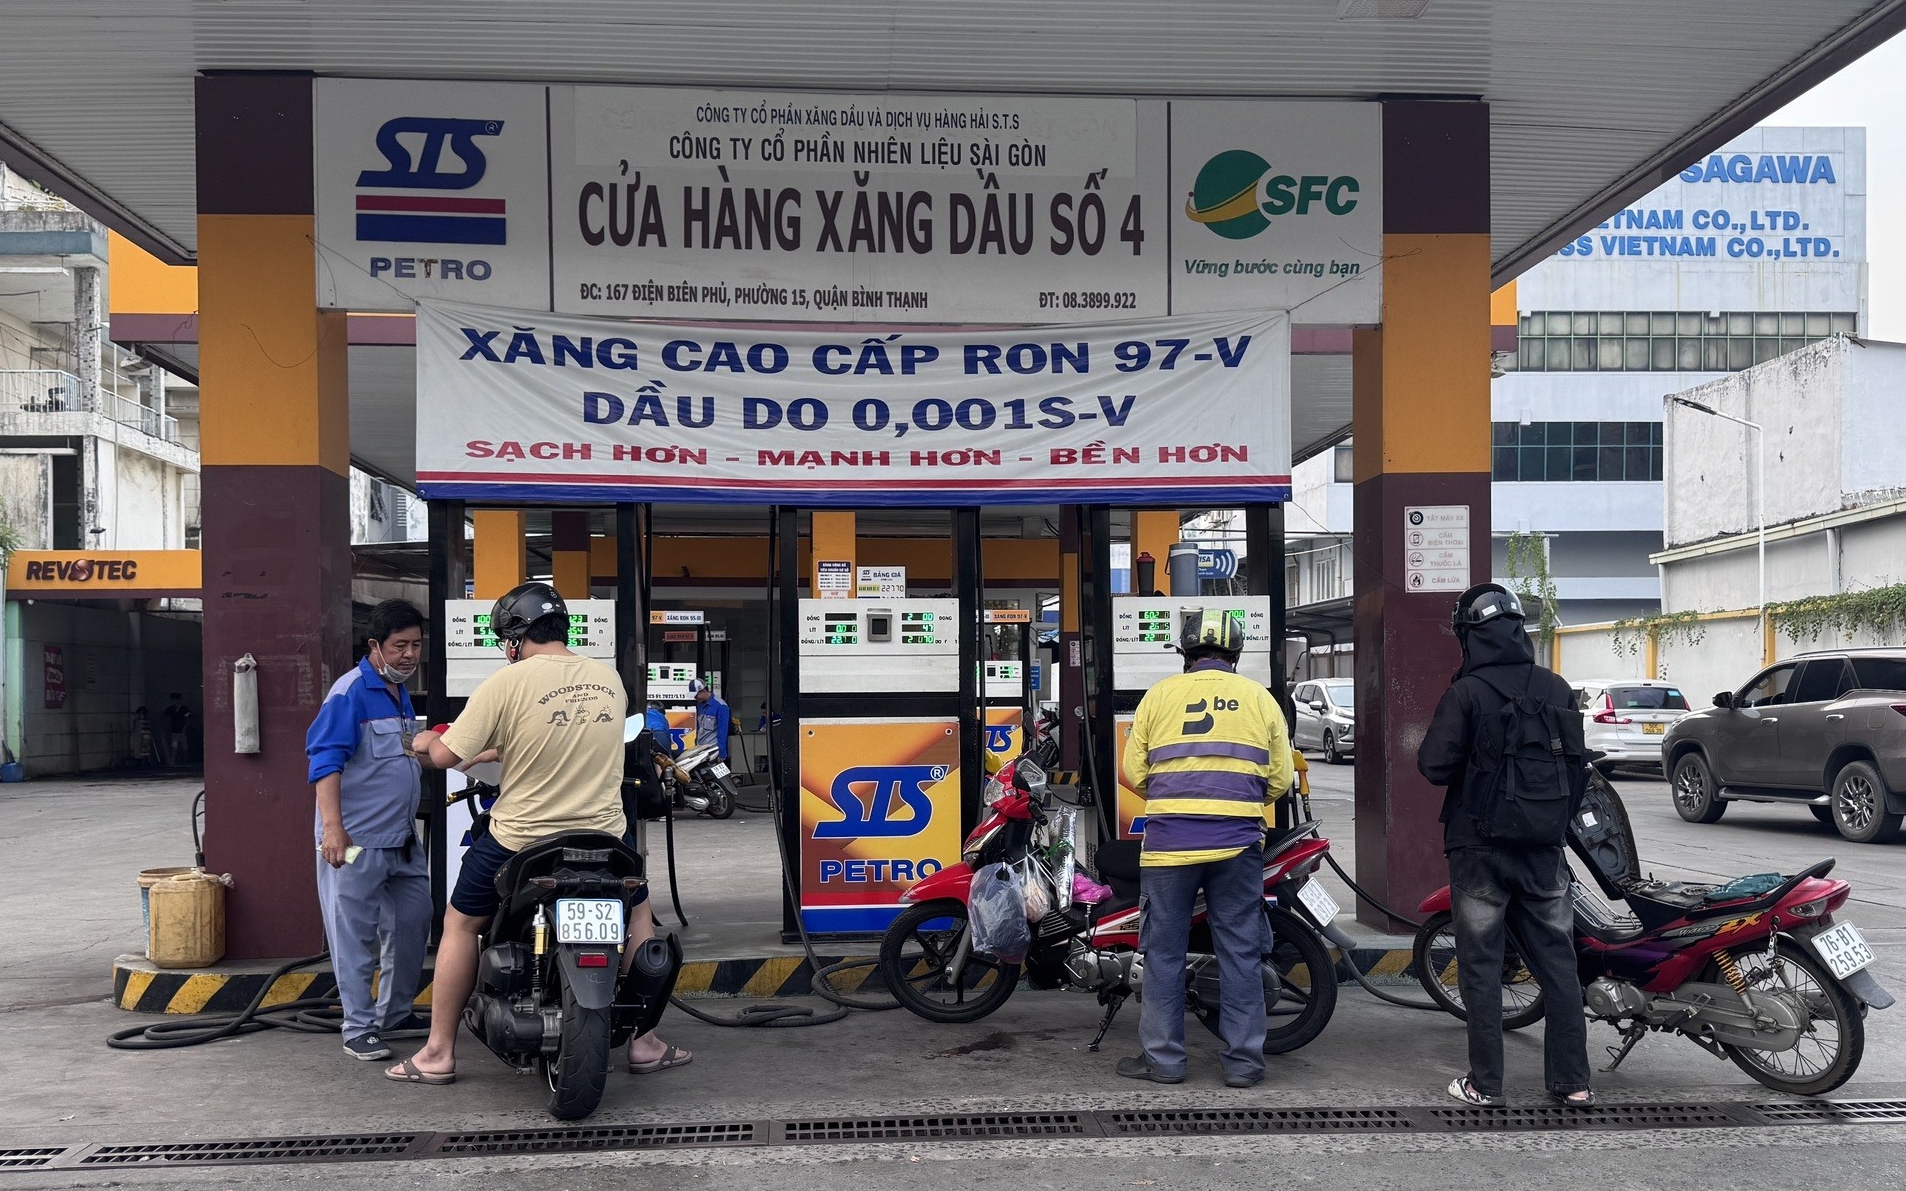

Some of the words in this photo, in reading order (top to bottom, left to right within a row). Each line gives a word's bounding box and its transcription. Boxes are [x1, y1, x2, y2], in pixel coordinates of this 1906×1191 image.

[696, 103, 730, 123] CÔNG
[733, 107, 748, 123] TY
[750, 100, 767, 124] CỔ
[771, 102, 801, 125] PHẦN
[805, 105, 837, 126] XĂNG
[841, 104, 864, 127] DẦU
[867, 108, 883, 127] VÀ
[886, 111, 913, 131] DỊCH
[916, 112, 931, 131] VỤ
[935, 108, 967, 129] HÀNG
[970, 107, 989, 130] HẢI
[992, 113, 1019, 130] S.T.S
[356, 117, 505, 190] STS
[669, 130, 721, 160] CÔNG
[729, 137, 753, 161] TY
[761, 127, 785, 162] CỔ
[794, 130, 845, 163] PHẦN
[853, 136, 912, 165] NHIÊN
[920, 137, 962, 170] LIỆU
[969, 138, 1000, 166] SÀI
[1008, 138, 1046, 167] GÒN
[1680, 154, 1837, 184] SAGAWA
[578, 159, 667, 247] CỬA
[683, 165, 801, 252] HÀNG
[815, 170, 932, 255] XĂNG
[950, 168, 1034, 255] DẦU
[1050, 168, 1109, 256] SỐ
[1120, 194, 1145, 256] 4
[1262, 175, 1360, 216] SFC
[1595, 209, 1683, 230] TNAM
[1558, 236, 1593, 257] SS
[1600, 236, 1717, 257] VIETNAM
[370, 256, 492, 281] PETRO
[1184, 259, 1229, 278] Vững
[1233, 258, 1278, 275] bước
[1283, 259, 1325, 278] cùng
[1329, 259, 1360, 278] bạn
[580, 283, 602, 301] ĐC:
[606, 284, 629, 301] 167
[632, 279, 664, 305] ĐIỆN
[667, 280, 698, 303] BIÊN
[701, 281, 731, 307] PHỦ,
[734, 282, 787, 306] PHƯỜNG
[791, 289, 810, 309] 15,
[813, 285, 848, 310] QUẬN
[852, 285, 883, 308] BÌNH
[886, 291, 928, 312] THẠNH
[1039, 292, 1060, 309] ĐT:
[1062, 292, 1136, 309] 08.3899.922
[459, 326, 639, 370] XĂNG
[661, 340, 790, 375] CAO
[812, 334, 939, 375] CẤP
[963, 342, 1089, 375] RON
[1113, 335, 1252, 373] 97-V
[583, 380, 714, 429] DẦU
[743, 397, 829, 430] DO
[852, 395, 1136, 438] 0,001S-V
[465, 440, 592, 462] SẠCH
[612, 444, 707, 465] HƠN
[758, 449, 890, 469] MẠNH
[910, 447, 1001, 466] HƠN
[1050, 440, 1140, 465] BỀN
[1158, 442, 1248, 463] HƠN
[538, 684, 616, 705] WOODSTOCK
[1213, 696, 1239, 711] be
[812, 765, 950, 839] STS
[820, 859, 942, 883] PETRO
[567, 903, 613, 921] 59-S2
[562, 922, 619, 941] 856.09
[1829, 942, 1873, 977] 259.53
